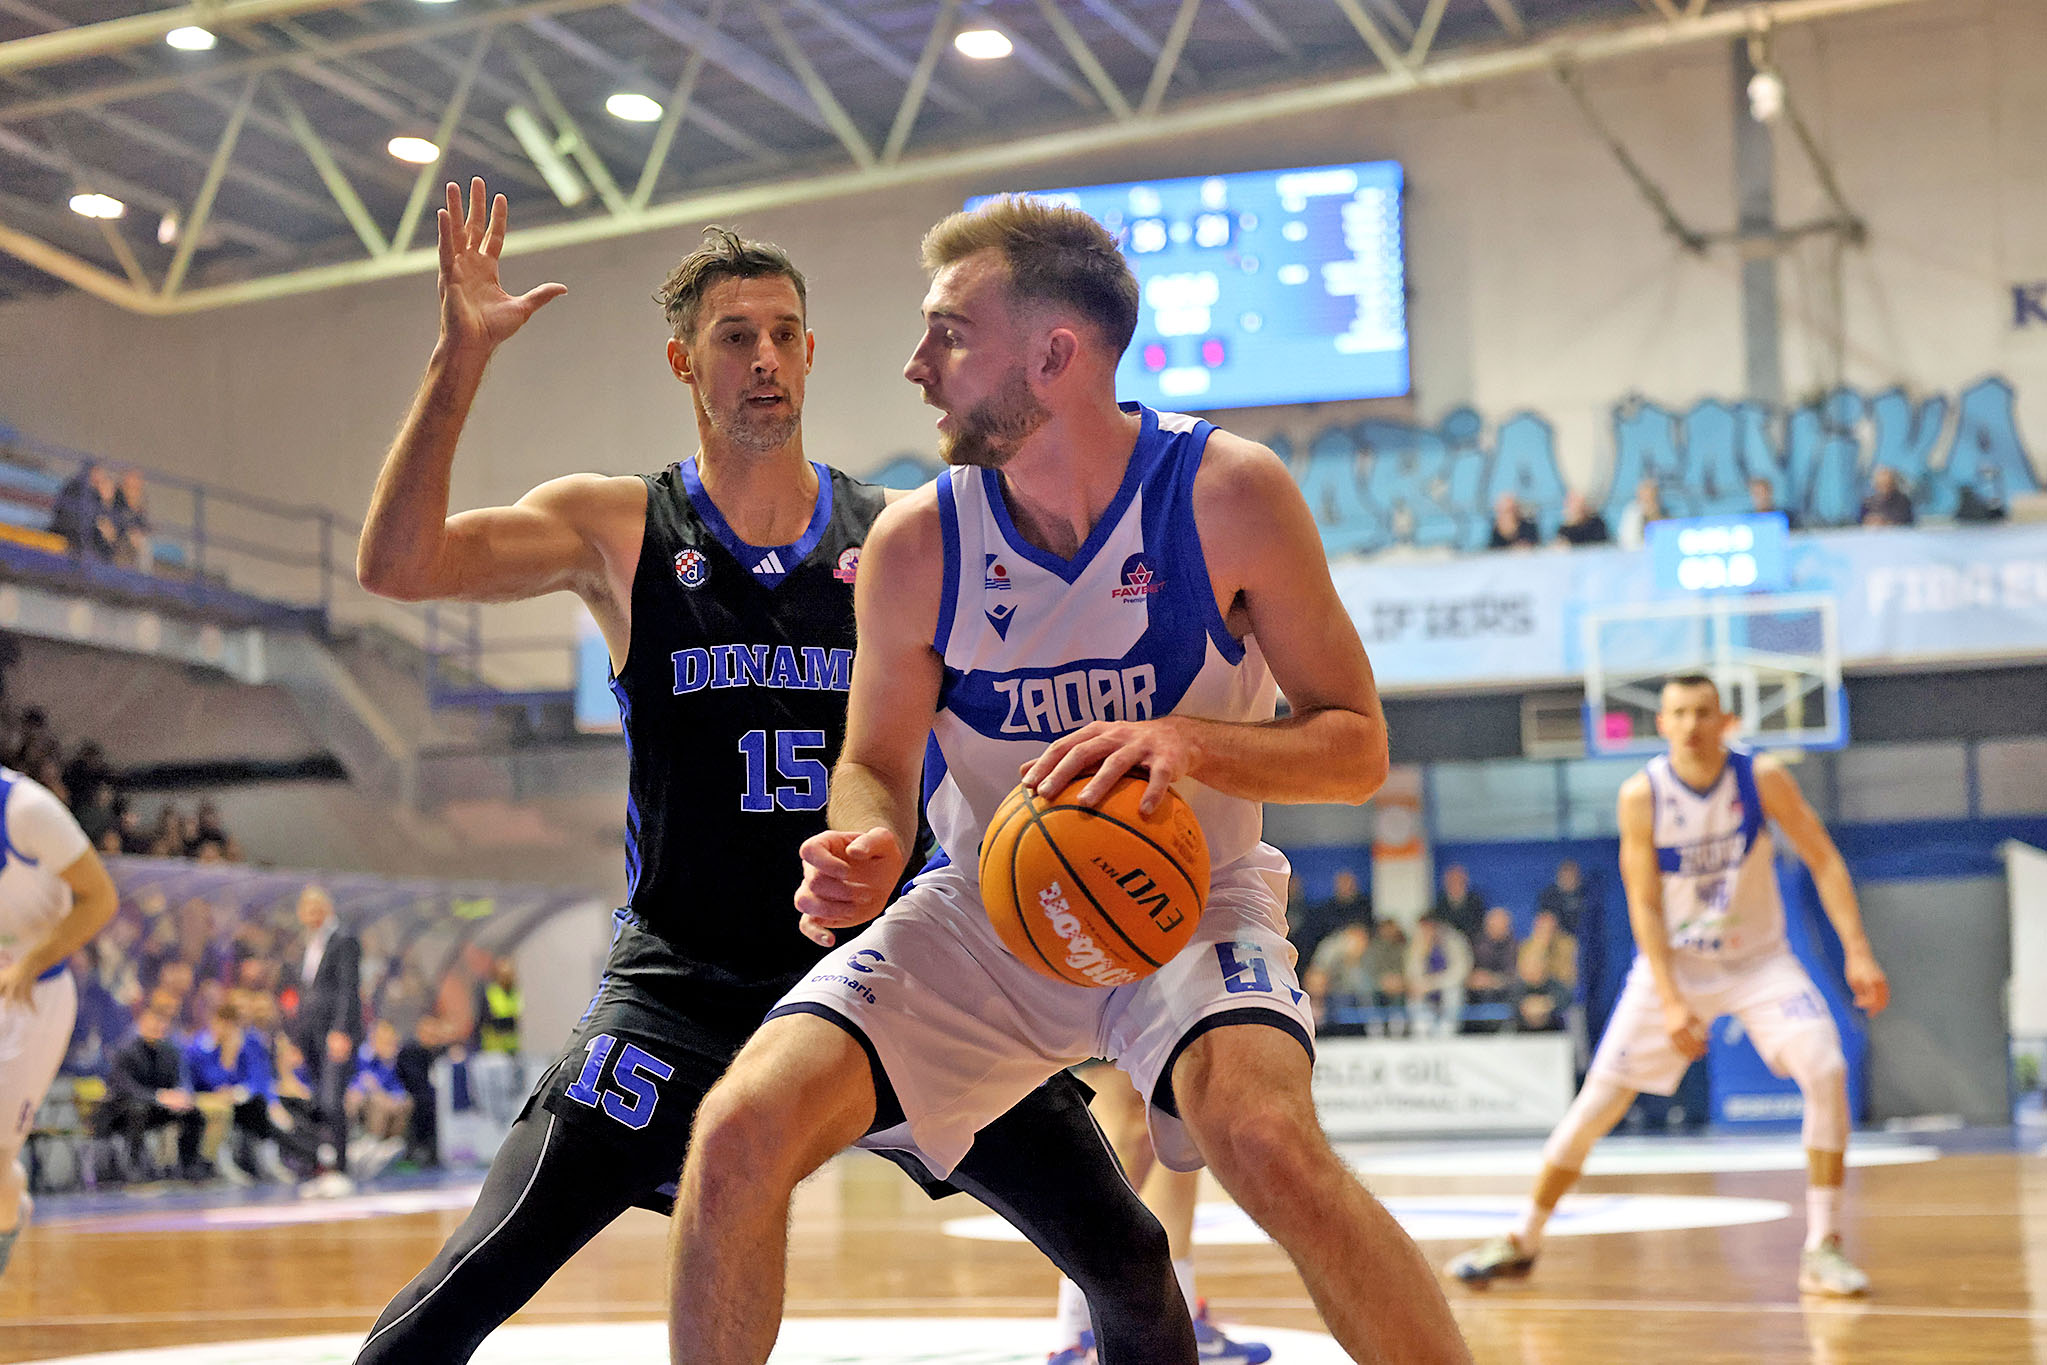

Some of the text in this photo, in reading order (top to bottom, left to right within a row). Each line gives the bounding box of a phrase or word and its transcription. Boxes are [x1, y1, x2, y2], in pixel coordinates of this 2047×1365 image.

[671, 643, 853, 695] DINAM
[993, 663, 1157, 734] ZADAR
[738, 729, 829, 812] 15
[1091, 856, 1185, 934] EVO NXT
[811, 974, 877, 1005] cromaris
[1215, 941, 1273, 994] 5
[564, 1033, 675, 1130] 15
